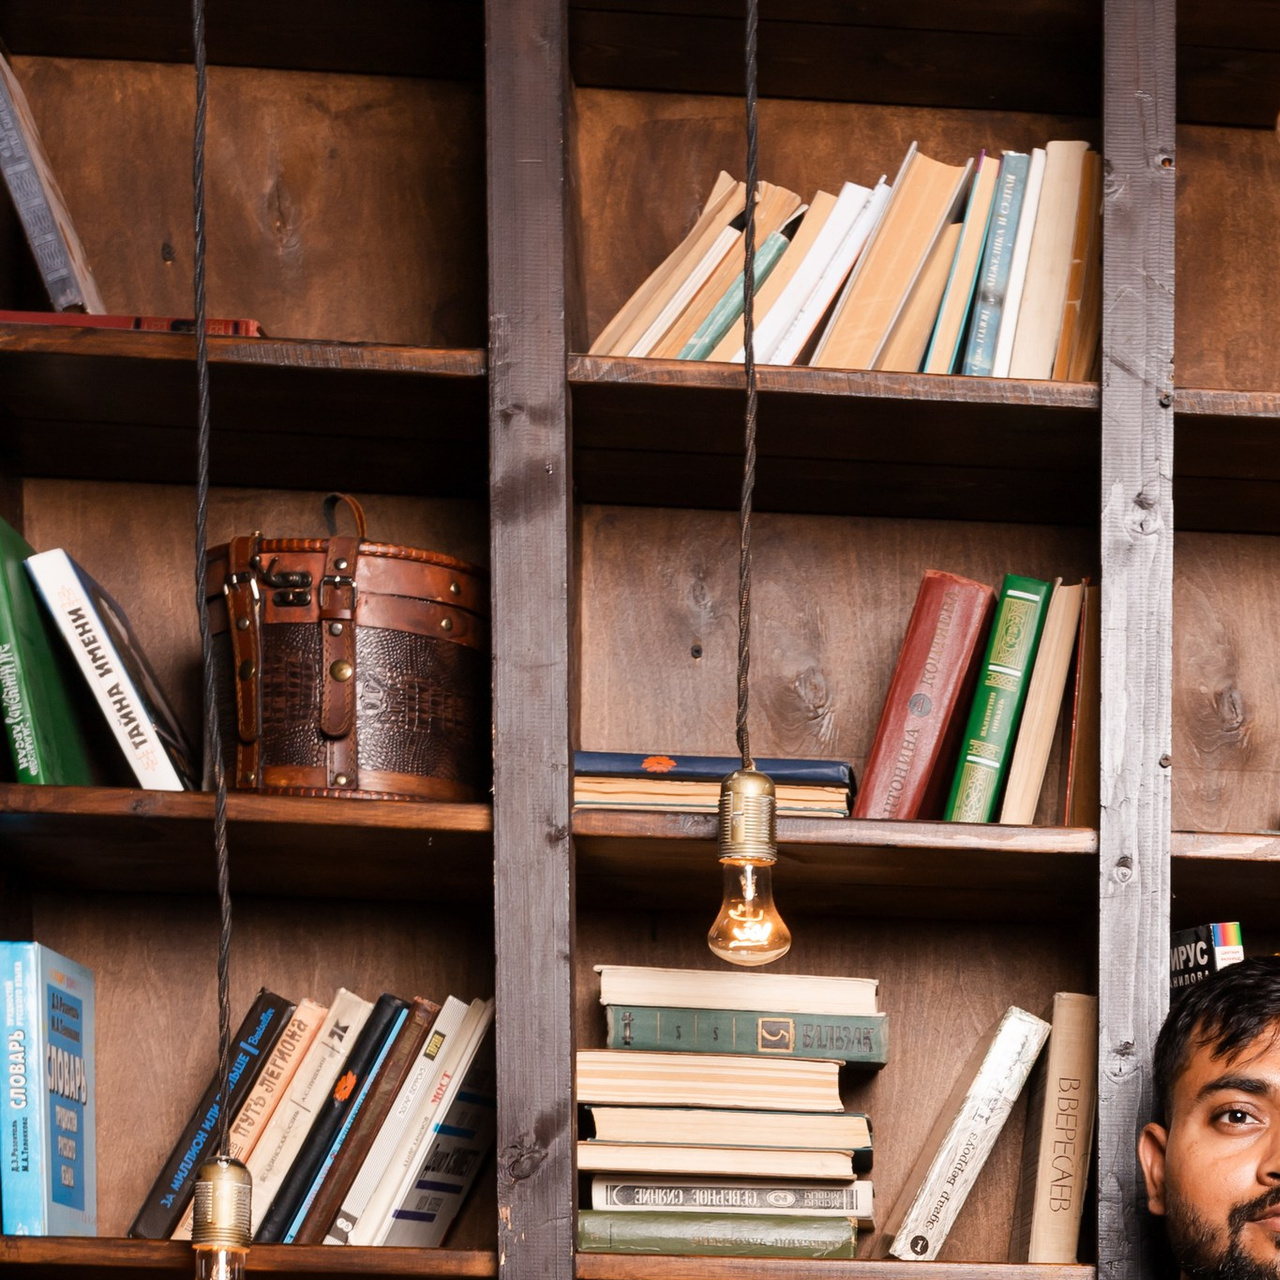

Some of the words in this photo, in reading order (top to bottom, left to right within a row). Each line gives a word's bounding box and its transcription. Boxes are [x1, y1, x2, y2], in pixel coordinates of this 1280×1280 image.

[66, 604, 114, 679] ИМЕНИ
[101, 680, 149, 752] ТАЙНА
[10, 1029, 27, 1111] СЛОВАРЬ
[46, 1042, 87, 1106] СЛОВАРЬ
[801, 1024, 874, 1053] БАЛЬЗАК
[231, 1090, 269, 1140] ПУТЬ
[256, 1015, 309, 1094] ЛЕГИОНА
[429, 1070, 453, 1106] МОСТ
[159, 1190, 176, 1209] ЗА
[168, 1129, 208, 1191] МИЛЛИОН
[201, 1102, 223, 1130] ИЛИ
[1048, 1076, 1080, 1213] В.ВЕРЕСАЕВ
[633, 1188, 683, 1203] СИЯНИЕ
[690, 1188, 757, 1204] СЕВЕРНОЕ
